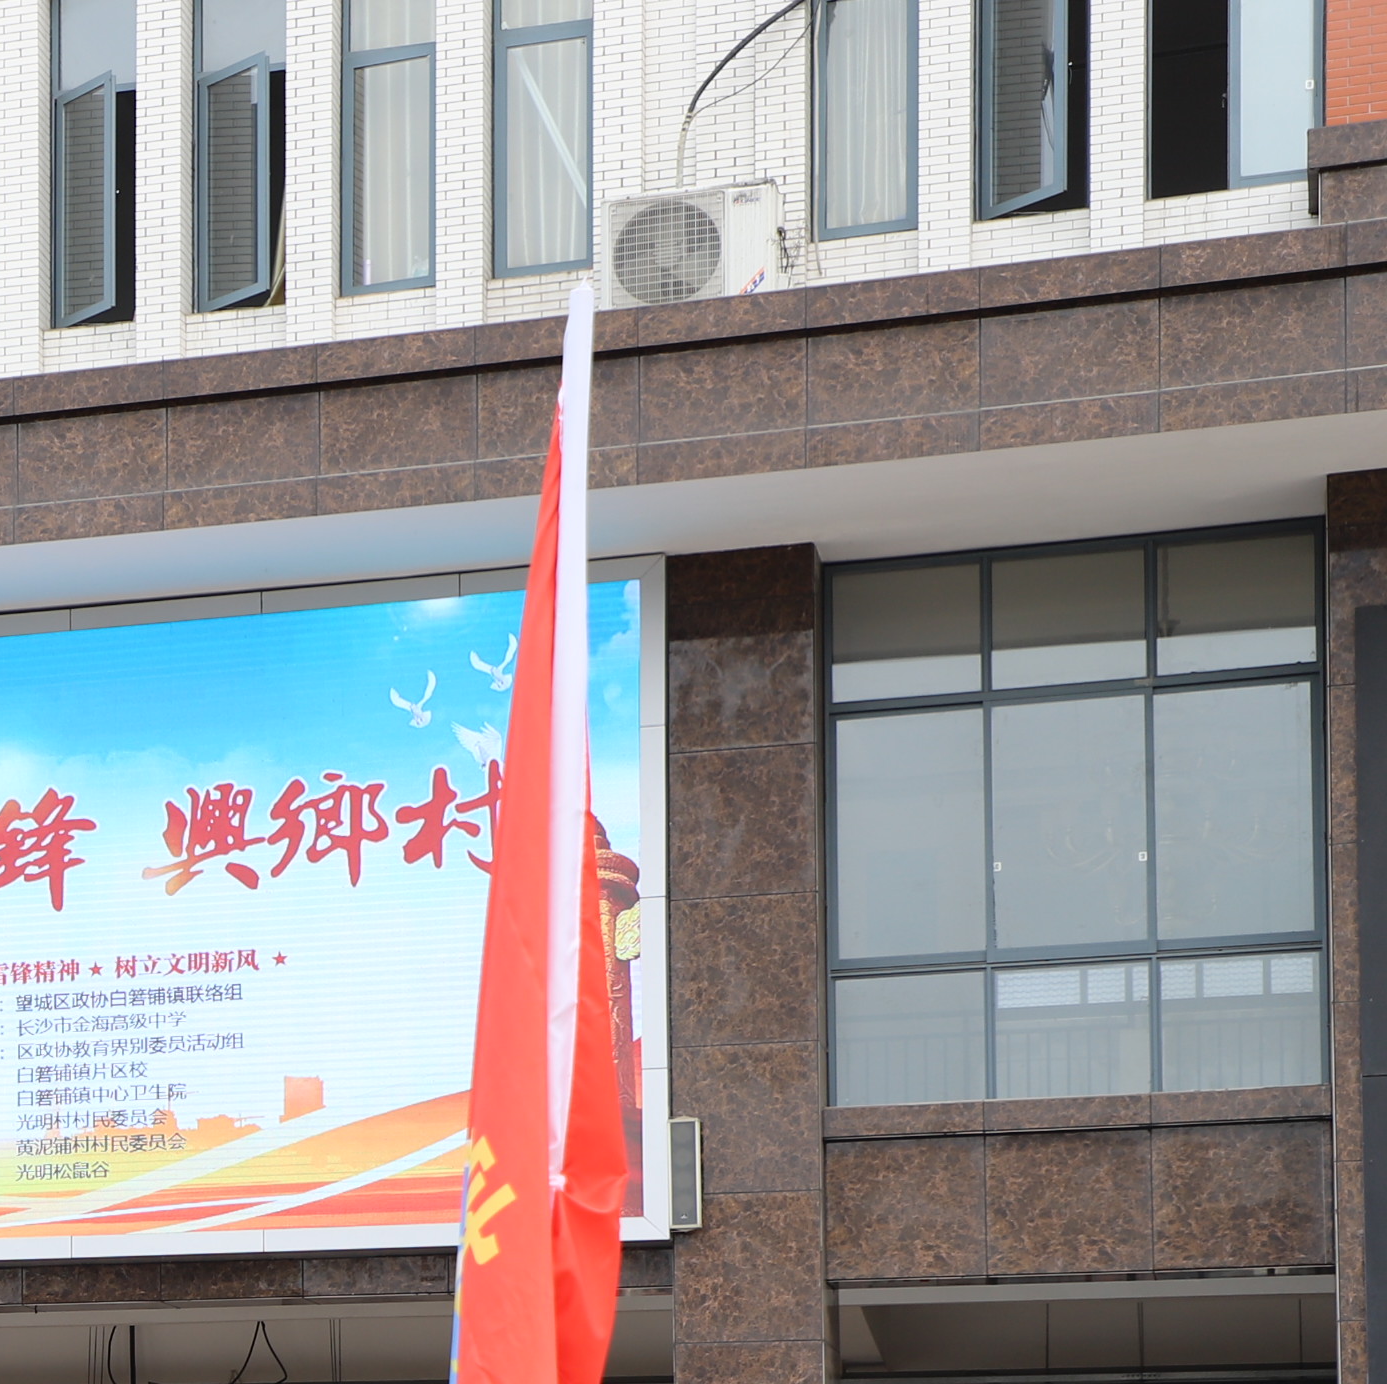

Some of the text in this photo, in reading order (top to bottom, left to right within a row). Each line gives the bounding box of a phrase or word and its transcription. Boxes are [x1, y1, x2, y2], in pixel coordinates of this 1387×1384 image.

[115, 949, 260, 979] 树立文明新风
[17, 1060, 149, 1085] 白箬铺镇片区校
[17, 1082, 187, 1108] 白箬铺镇中心卫生院
[15, 1108, 168, 1132] 光明村村民委员会
[16, 1132, 187, 1157] 黄泥铺村村民委员会
[15, 1160, 110, 1182] 光明松鼠谷
